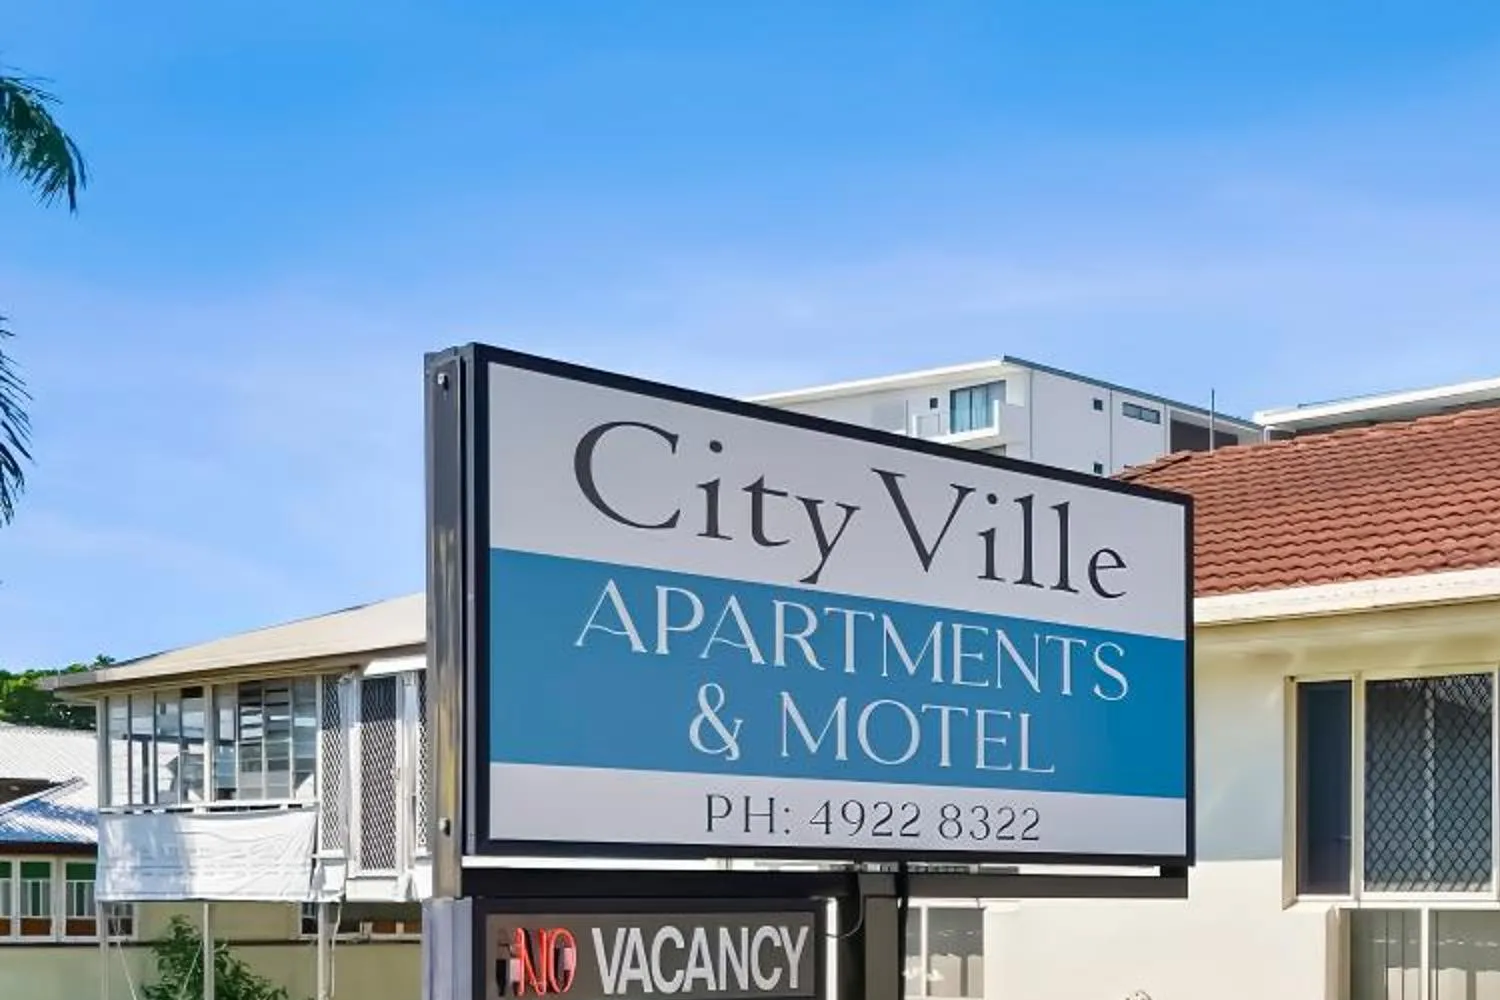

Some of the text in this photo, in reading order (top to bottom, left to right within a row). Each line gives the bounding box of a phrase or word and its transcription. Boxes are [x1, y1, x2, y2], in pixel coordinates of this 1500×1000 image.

[575, 578, 1129, 701] APARTMENTS
[689, 682, 1055, 774] & MOTEL
[705, 794, 1041, 842] PH: 4922 8322
[513, 926, 810, 997] NO VACANCY
